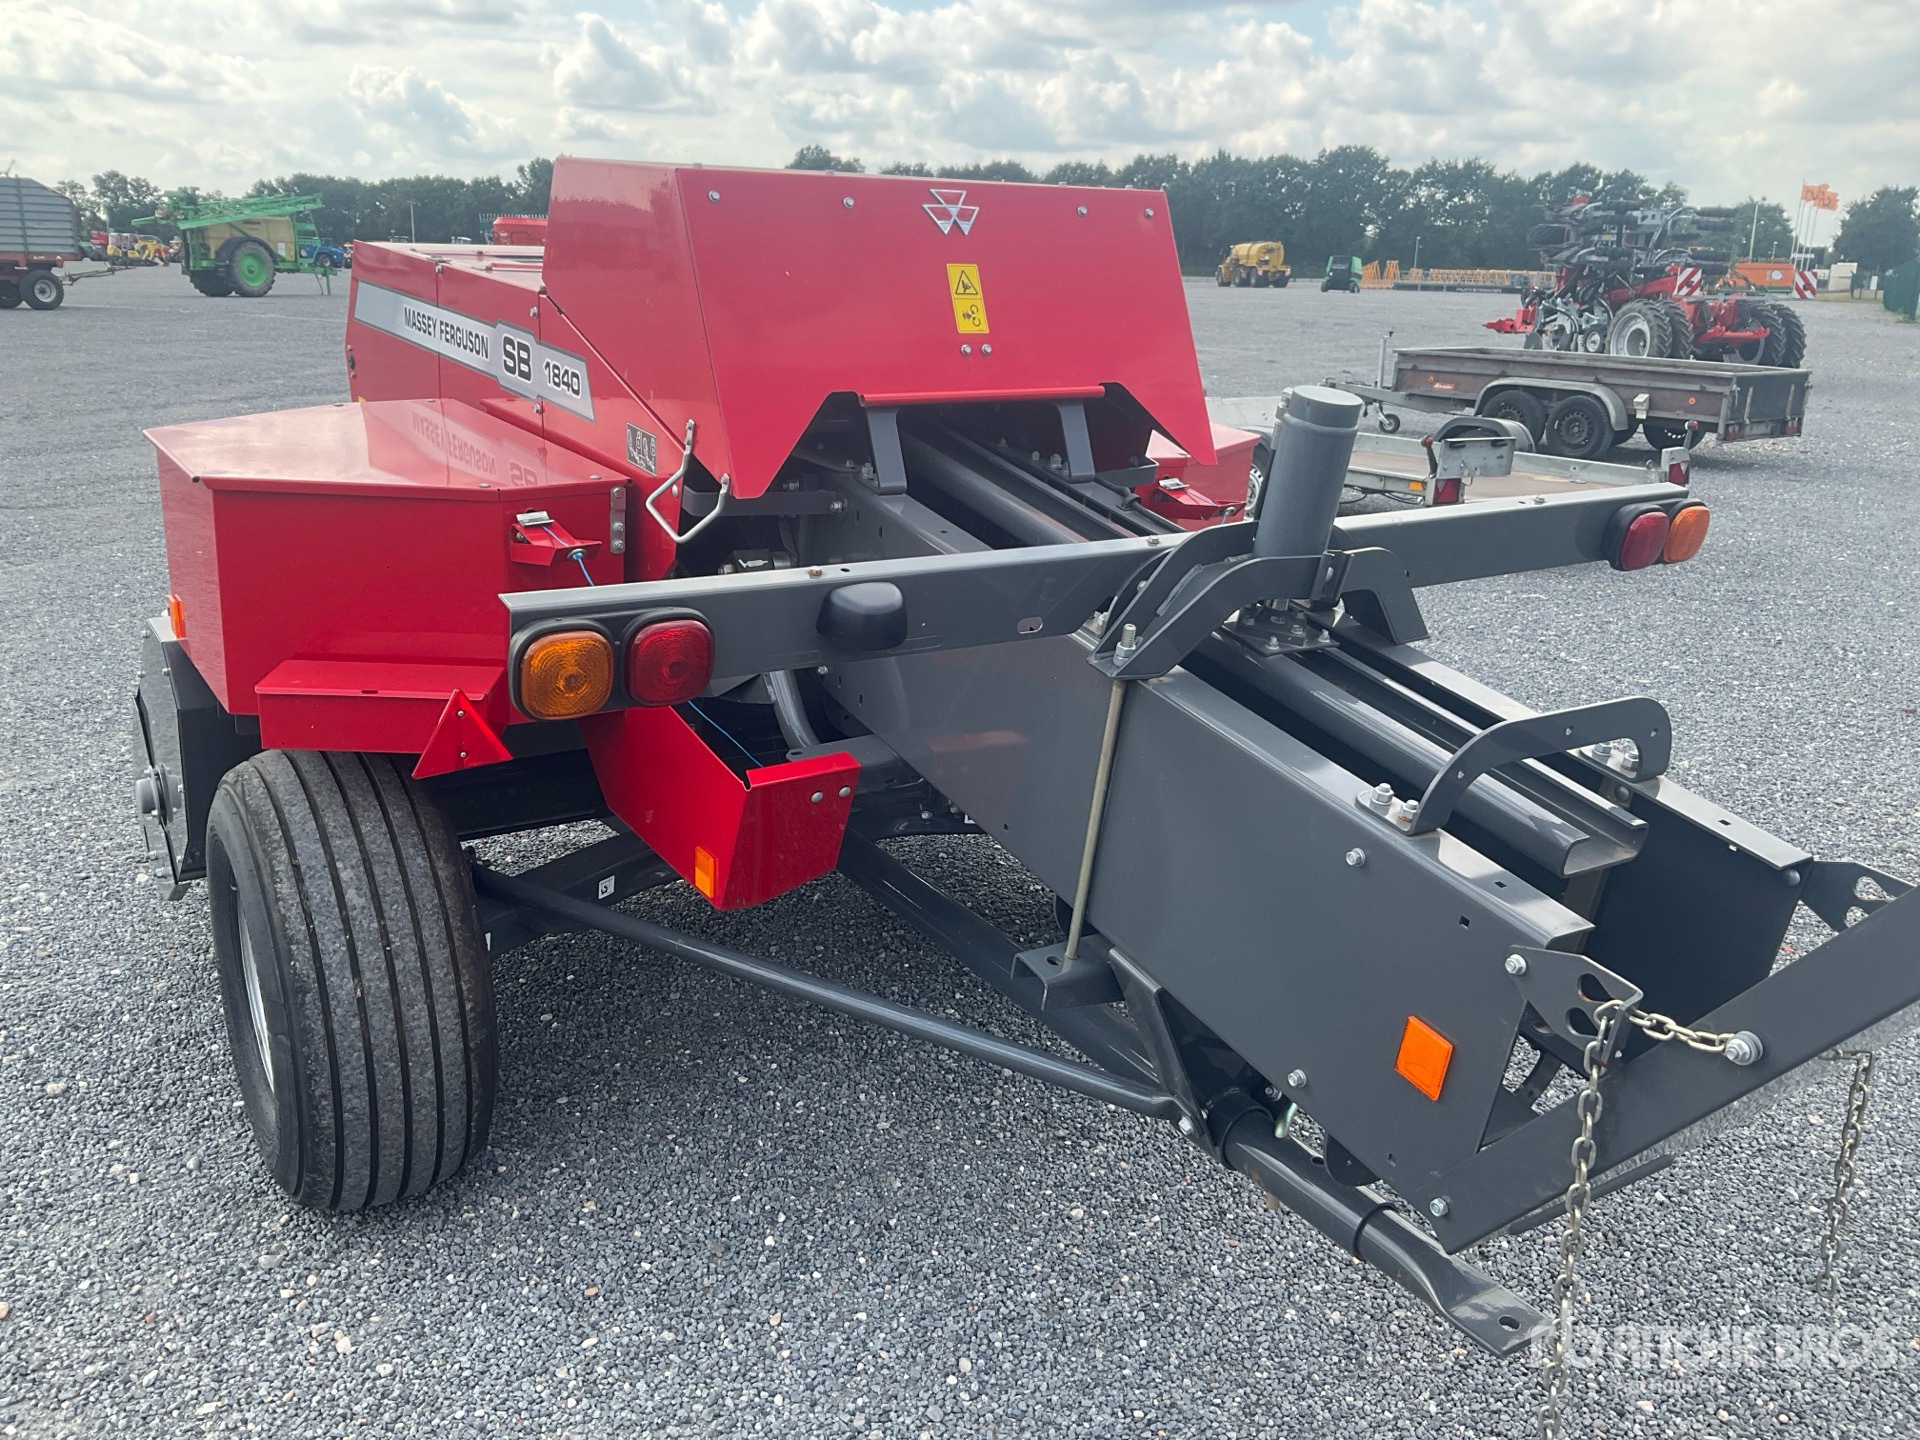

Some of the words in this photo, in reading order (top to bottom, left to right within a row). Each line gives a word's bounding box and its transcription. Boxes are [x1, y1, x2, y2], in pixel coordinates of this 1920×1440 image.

[404, 306, 437, 339] MASSEY
[440, 319, 488, 360] FERGUSON
[502, 335, 532, 382] SB
[544, 360, 581, 397] 1840
